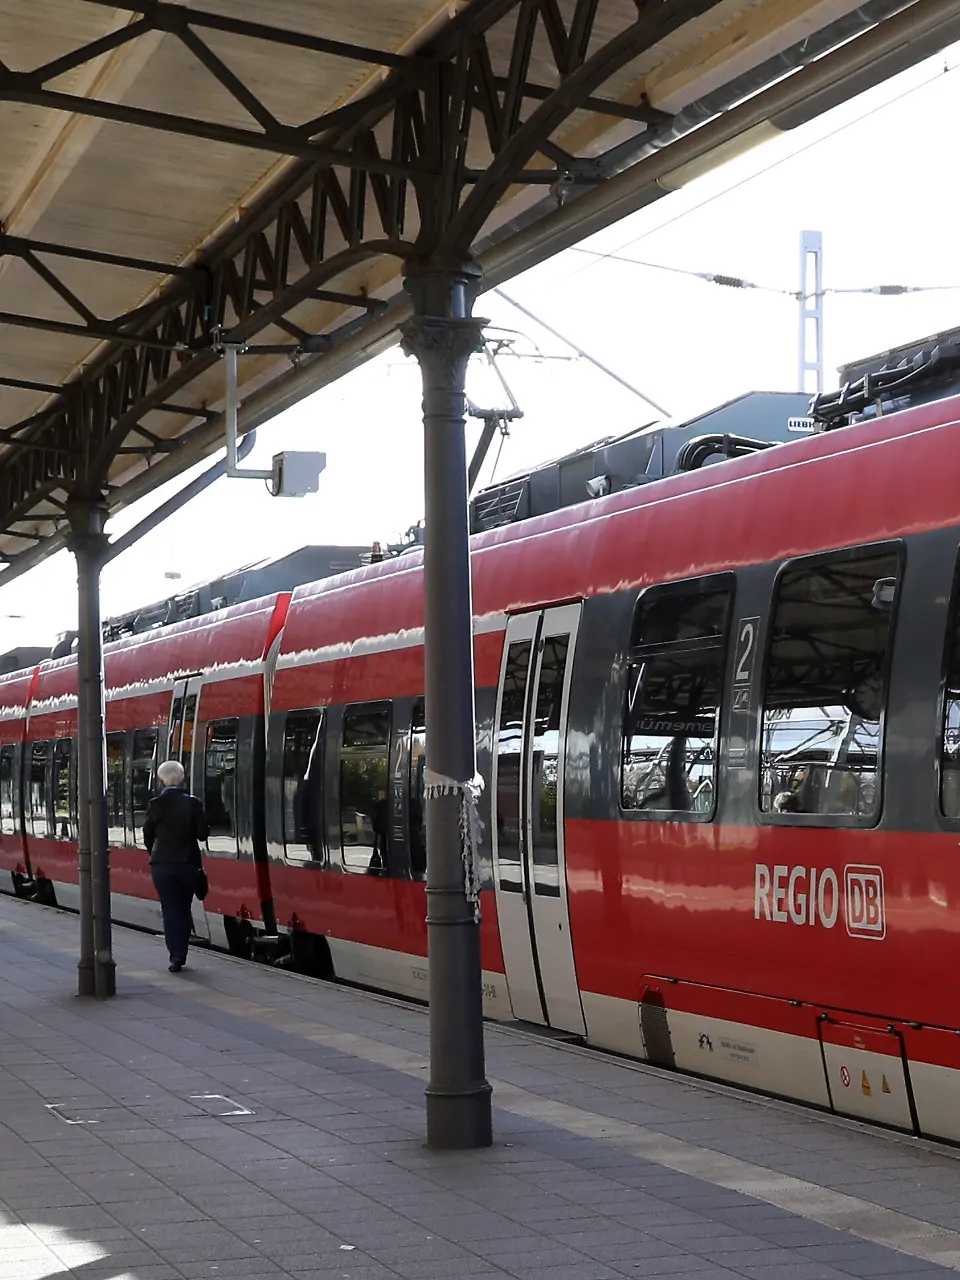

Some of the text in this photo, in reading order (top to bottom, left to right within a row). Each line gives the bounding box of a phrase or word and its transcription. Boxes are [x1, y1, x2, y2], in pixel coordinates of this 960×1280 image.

[735, 623, 754, 680] 2
[395, 737, 403, 778] 2
[754, 863, 882, 931] REGIO DB
